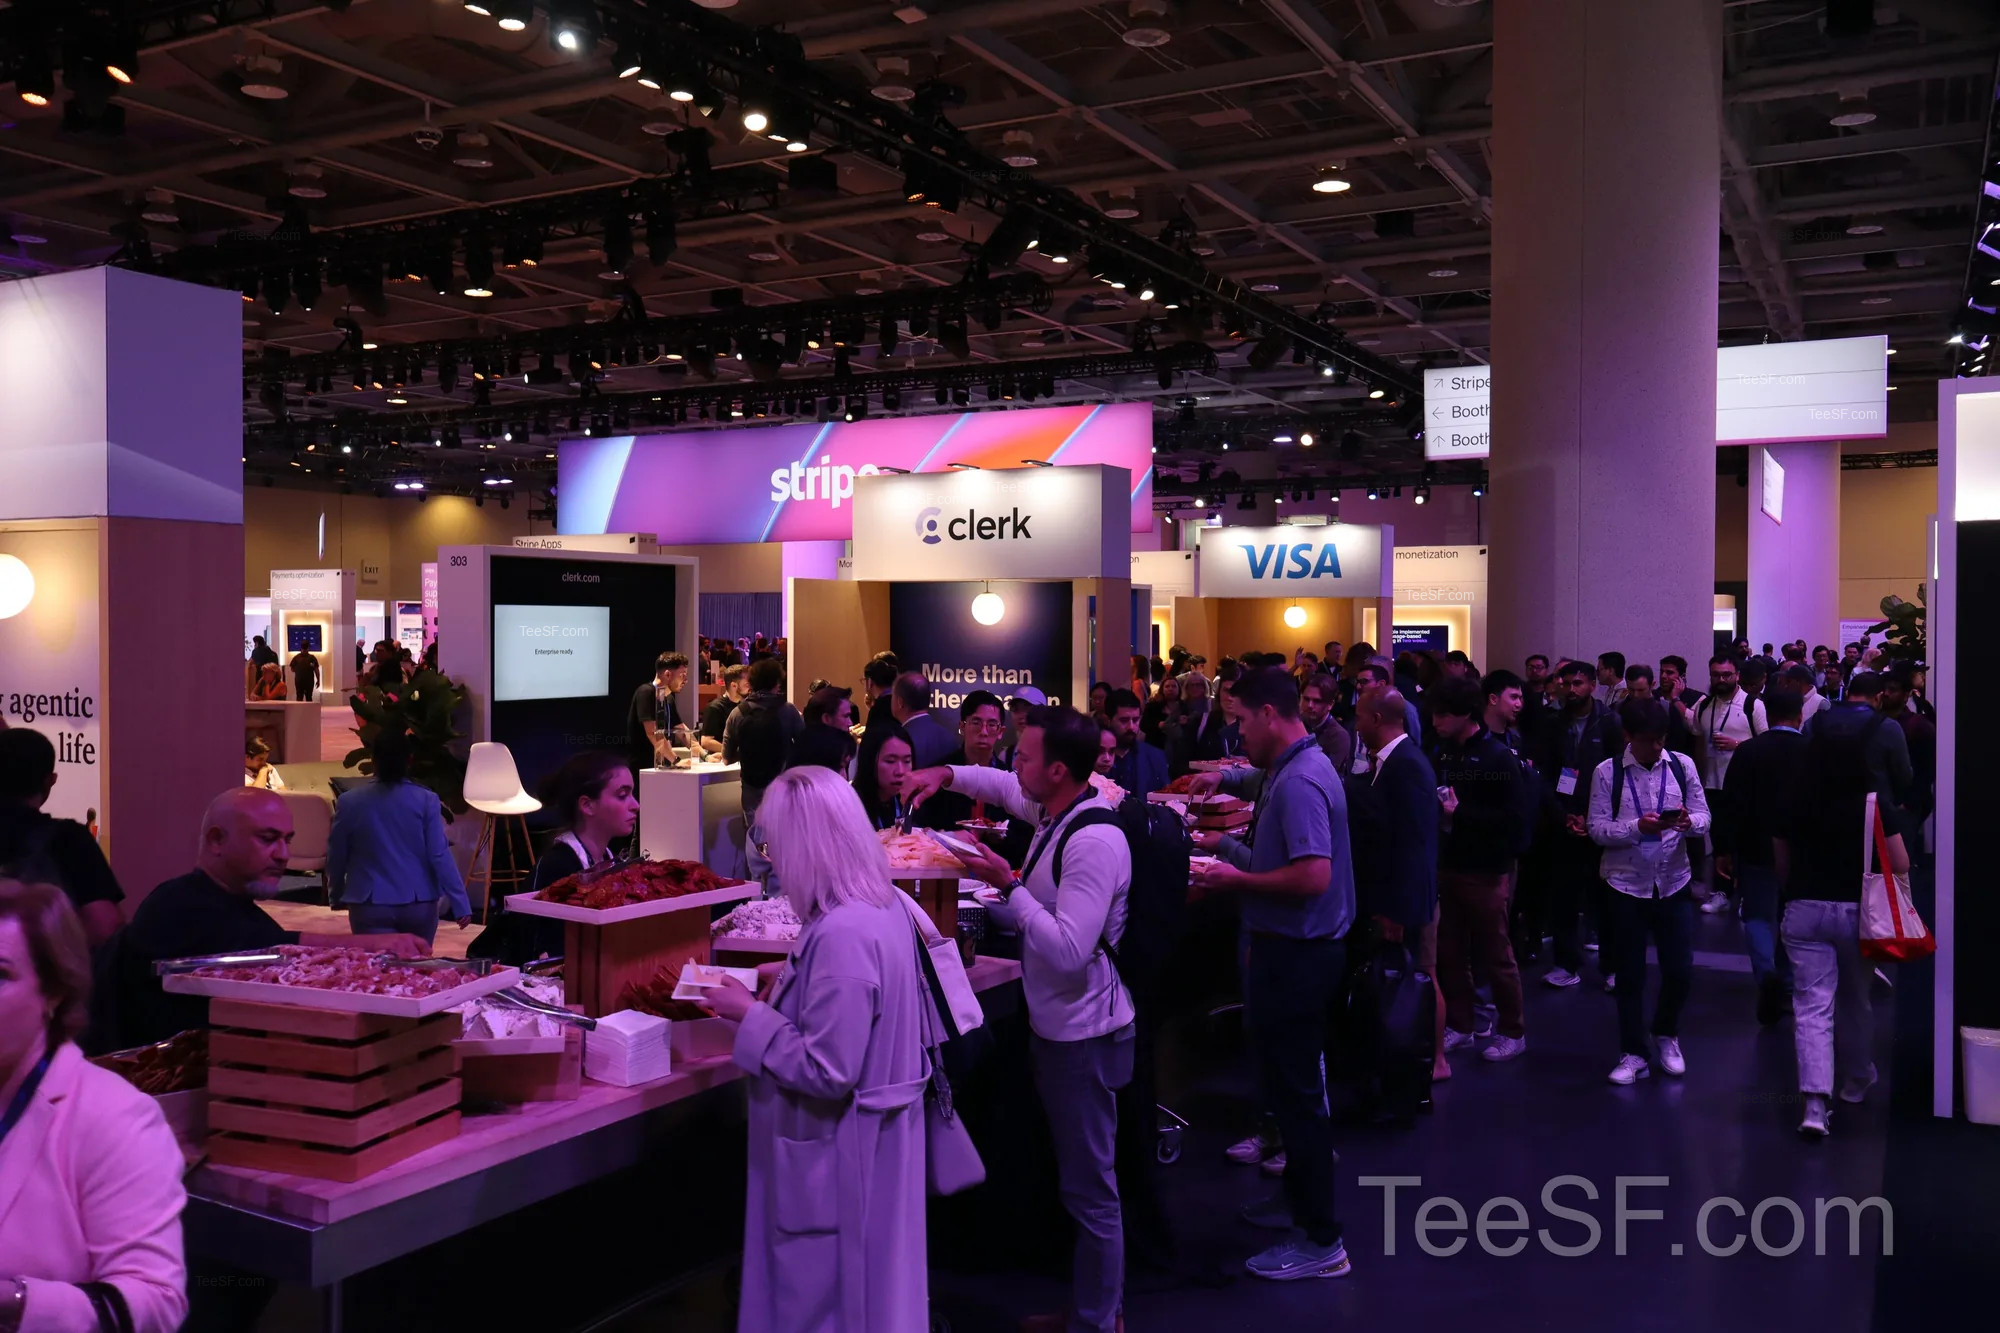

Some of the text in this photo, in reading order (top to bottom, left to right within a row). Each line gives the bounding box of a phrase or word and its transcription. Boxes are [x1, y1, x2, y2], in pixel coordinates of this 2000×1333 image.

[1451, 376, 1490, 391] Stripe
[948, 507, 1032, 541] clerk
[450, 556, 467, 566] 303
[1237, 543, 1342, 579] VISA
[1395, 549, 1459, 560] monetization
[272, 572, 325, 580] Payments optimization
[562, 572, 600, 583] clerk.com
[534, 648, 573, 656] Enterprise ready
[922, 663, 1032, 685] More than
[9, 687, 94, 723] agentic
[58, 732, 96, 765] life
